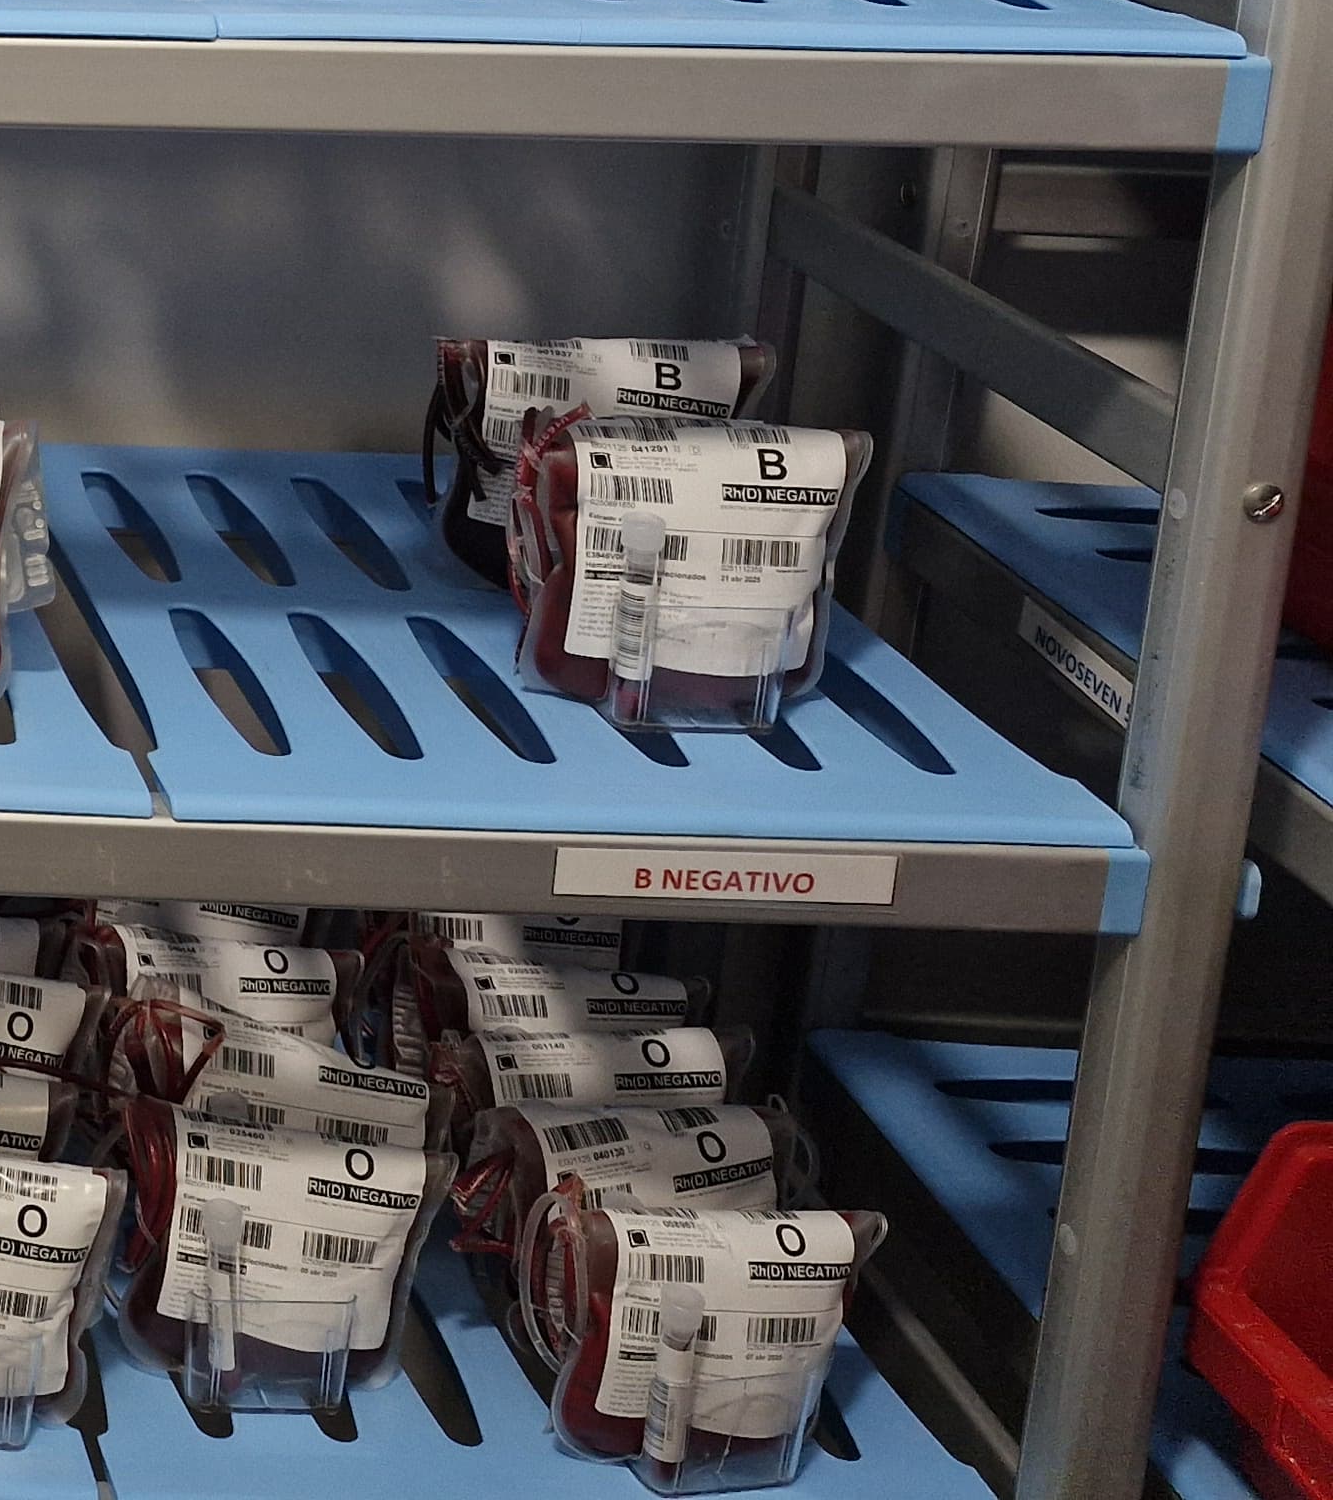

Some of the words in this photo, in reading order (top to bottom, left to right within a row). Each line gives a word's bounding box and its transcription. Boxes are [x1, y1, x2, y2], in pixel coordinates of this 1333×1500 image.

[654, 363, 682, 391] B
[617, 390, 656, 407] Rh(D)
[659, 396, 730, 417] NEGATIVO
[756, 449, 788, 480] B
[722, 485, 763, 502] Rh(D)
[766, 488, 837, 504] NEGATIVO
[1035, 624, 1122, 713] NOVOSEVEN
[635, 868, 652, 889] B
[662, 869, 815, 894] NEGATIVO
[236, 905, 299, 928] NEGATIVO
[264, 948, 289, 974] O
[239, 979, 271, 992] Rh(D)
[273, 980, 331, 993] NEGATIVO
[612, 972, 639, 996] O
[587, 1000, 621, 1015] Rh(D)
[624, 1001, 687, 1015] NEGATIVO
[7, 1011, 34, 1042] O
[641, 1038, 671, 1068] O
[319, 1067, 355, 1084] Rh(D)
[357, 1074, 427, 1097] NEGATIVO
[615, 1073, 652, 1089] Rh(D)
[656, 1072, 722, 1087] NEGATIVO
[696, 1130, 726, 1163] O
[344, 1148, 375, 1181] O
[674, 1173, 709, 1193] Rh(D)
[712, 1158, 772, 1187] NEGATIVO
[308, 1179, 347, 1199] Rh(D)
[349, 1187, 420, 1209] NEGATIVO
[17, 1204, 48, 1238] O
[19, 1242, 87, 1262] NEGATIVO
[776, 1223, 806, 1257] O
[749, 1261, 786, 1279] Rh(D)
[787, 1263, 851, 1280] NEGATIVO
